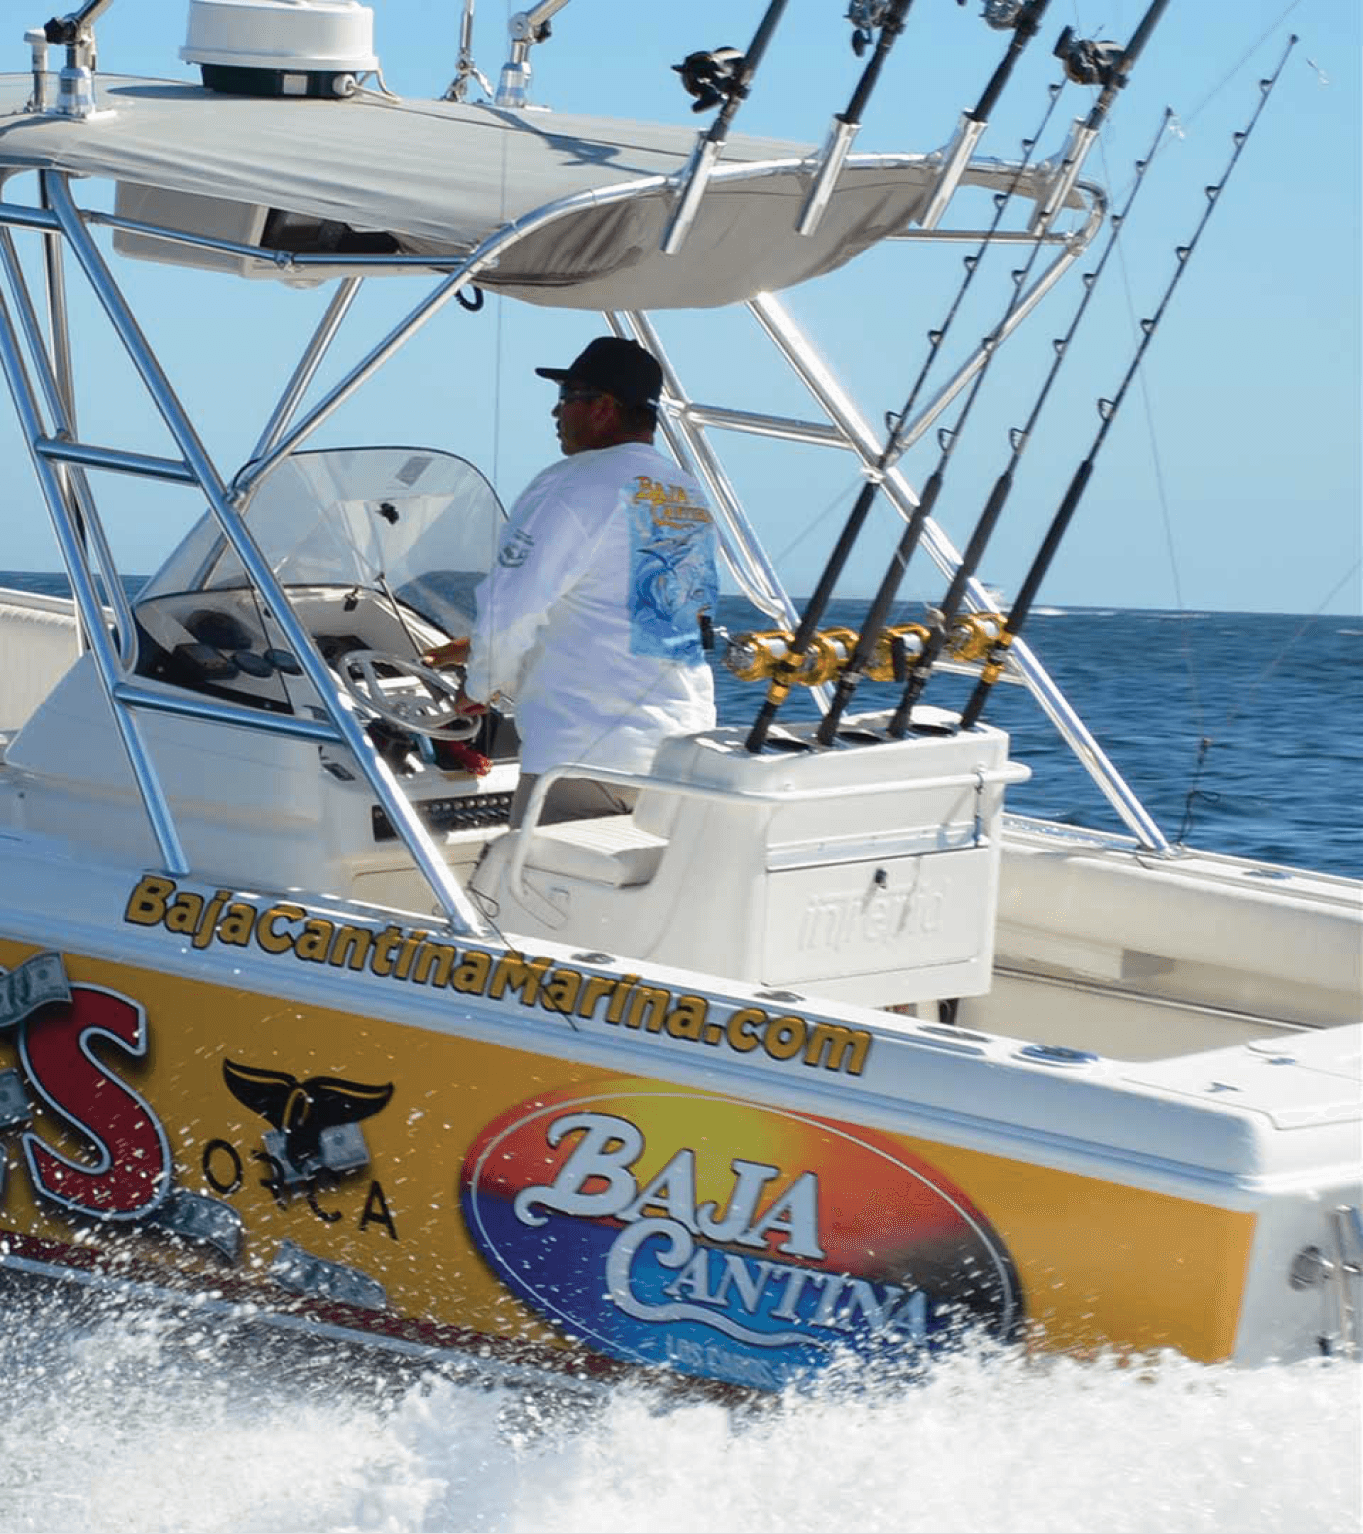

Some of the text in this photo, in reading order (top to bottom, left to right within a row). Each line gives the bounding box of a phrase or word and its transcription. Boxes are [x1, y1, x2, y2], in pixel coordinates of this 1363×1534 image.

[124, 875, 873, 1076] BajaCantinaMarina.com
[513, 1111, 827, 1261] BAJA
[604, 1219, 931, 1348] CANTINA
